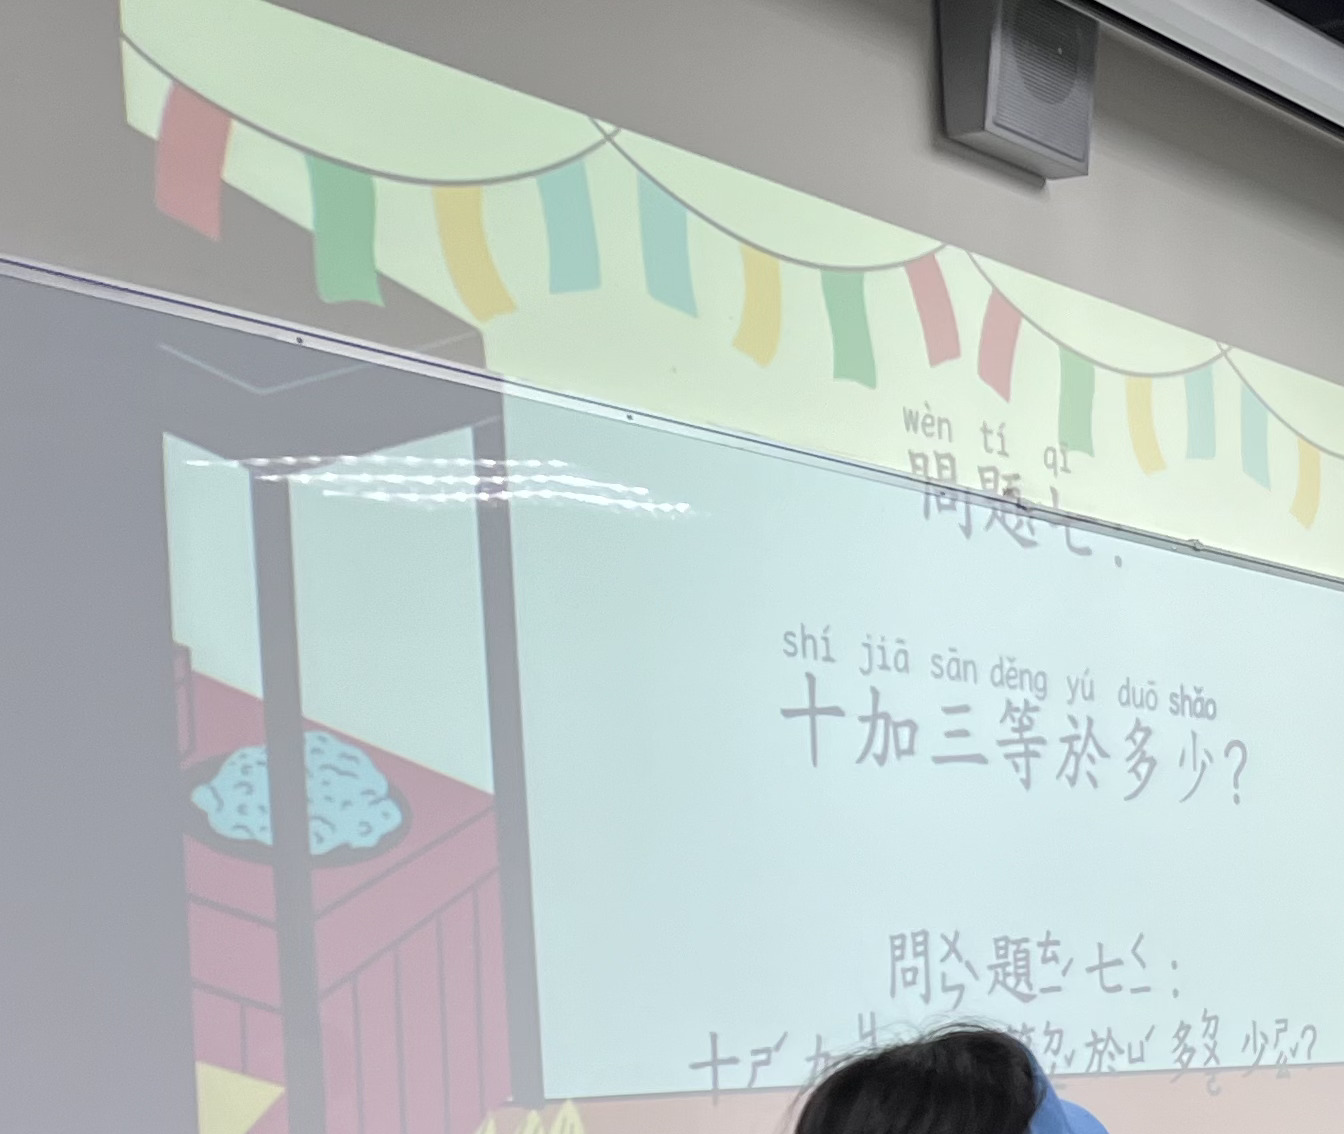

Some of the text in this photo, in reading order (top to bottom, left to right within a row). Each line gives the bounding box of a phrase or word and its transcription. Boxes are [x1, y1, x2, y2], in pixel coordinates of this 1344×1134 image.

[903, 400, 953, 443] wèn
[980, 420, 1010, 458] tí
[783, 622, 1218, 721] shí jiā sān děng yú duō shǎo
[780, 670, 1249, 806] 十加三等於多少?
